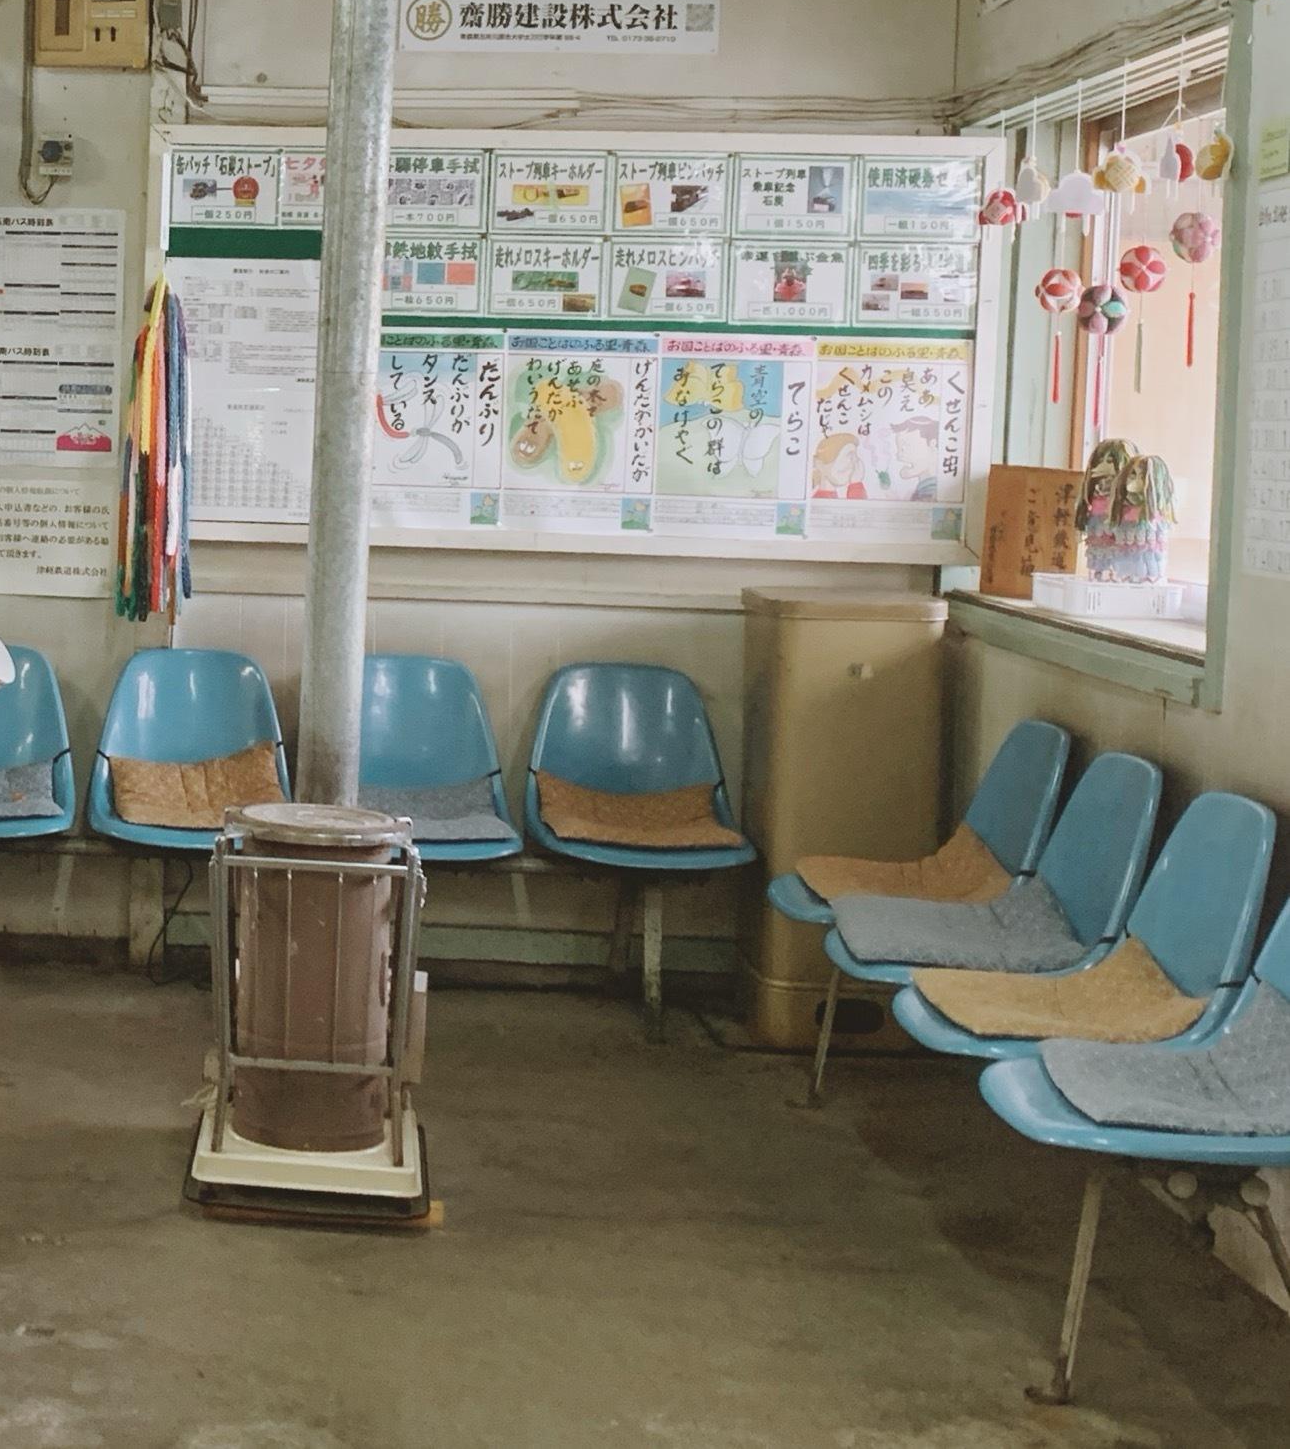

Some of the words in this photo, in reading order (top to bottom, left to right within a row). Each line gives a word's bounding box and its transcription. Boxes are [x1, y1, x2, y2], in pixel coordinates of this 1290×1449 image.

[414, 2, 446, 33] 勝
[742, 168, 807, 180] ストーブ列車
[752, 182, 795, 193] 乗車記念
[762, 195, 784, 208] 石炭
[495, 247, 600, 269] 走れメロスキーホルダー
[390, 355, 407, 430] している
[422, 355, 438, 405] ダンス
[749, 365, 770, 427] 青空の
[877, 369, 893, 406] この
[786, 381, 806, 456] てらこ
